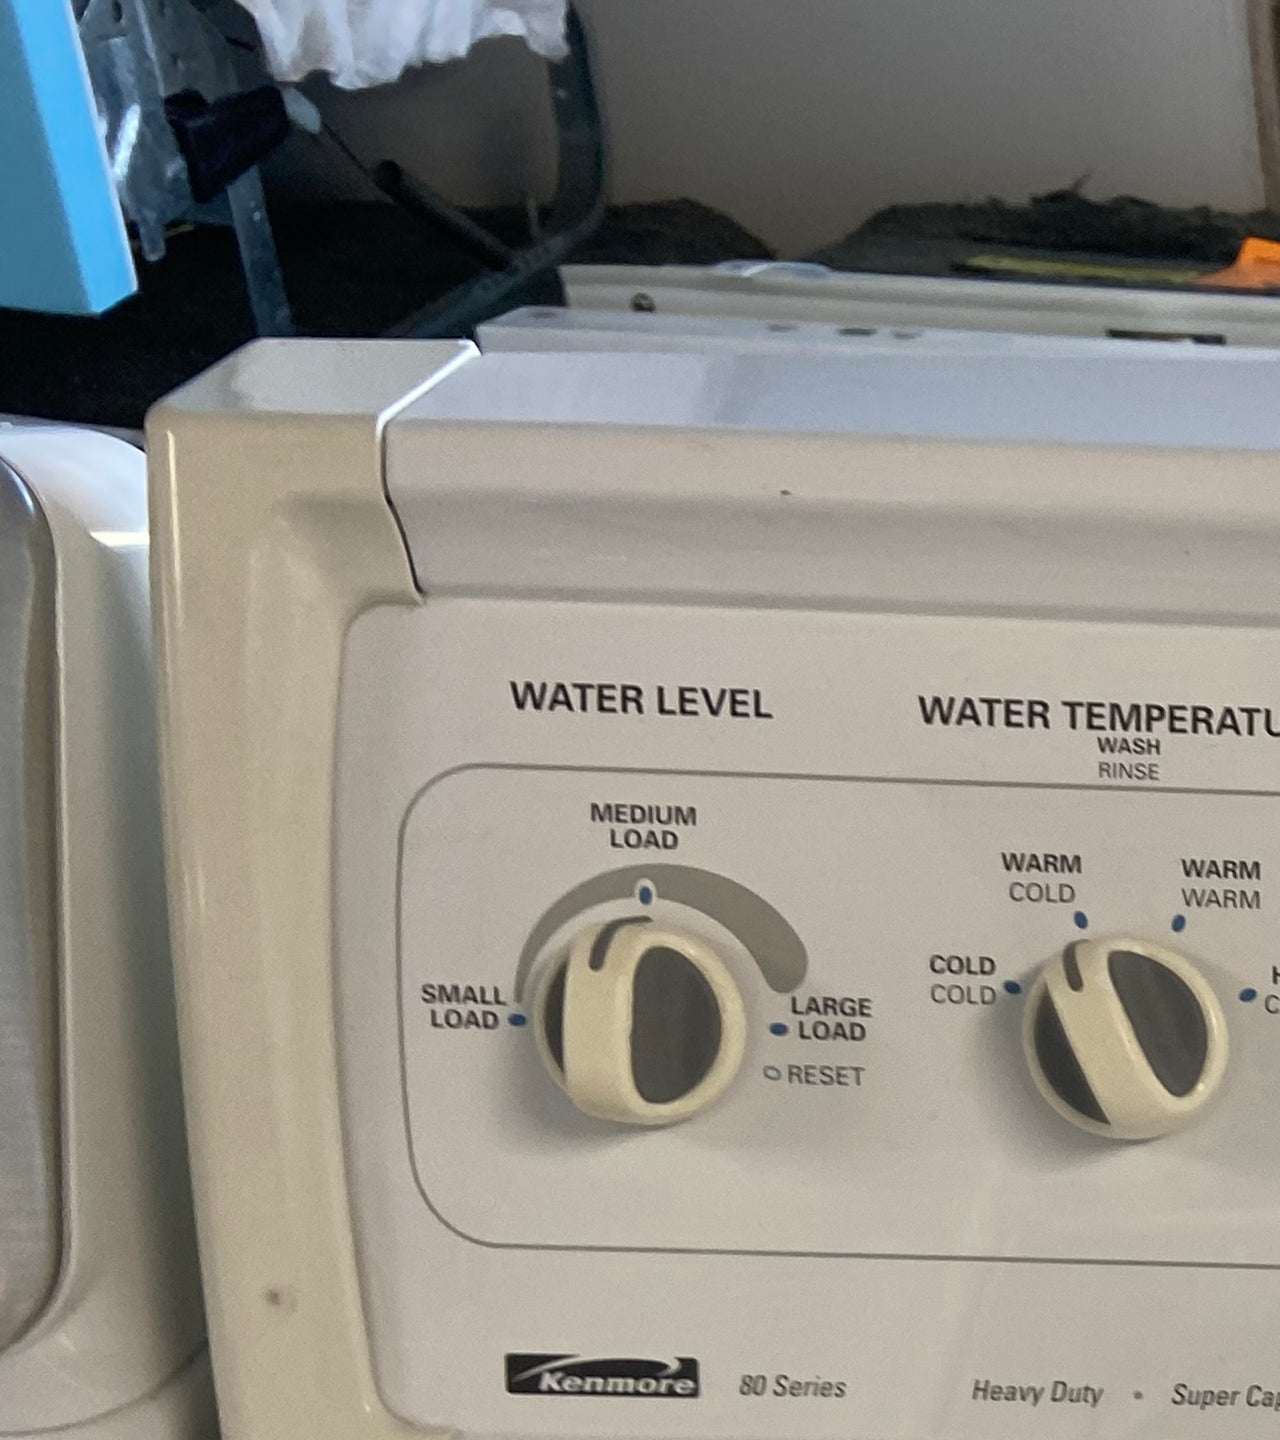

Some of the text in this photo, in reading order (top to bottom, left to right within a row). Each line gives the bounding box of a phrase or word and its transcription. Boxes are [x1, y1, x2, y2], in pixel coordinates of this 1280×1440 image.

[510, 681, 774, 719] WATER LEVEL
[919, 696, 1051, 730] WATER
[1097, 737, 1161, 756] WASH
[1098, 762, 1161, 780] RINSE
[590, 803, 697, 826] MEDIUM
[610, 829, 679, 850] LOAD
[1001, 852, 1082, 874] WARM
[1181, 859, 1262, 881] WARM
[1009, 882, 1076, 904] COLD
[1181, 888, 1262, 909] WARM
[929, 954, 996, 976] COLD
[421, 984, 507, 1006] SMALL
[930, 984, 997, 1006] COLD
[791, 997, 873, 1018] LARGE
[430, 1009, 499, 1030] LOAD
[798, 1021, 867, 1042] LOAD
[788, 1066, 865, 1087] RESET
[538, 1370, 695, 1394] Kenmore
[739, 1374, 847, 1399] 80 Series
[972, 1379, 1104, 1407] Heavy Duty
[1171, 1383, 1241, 1412] Super
